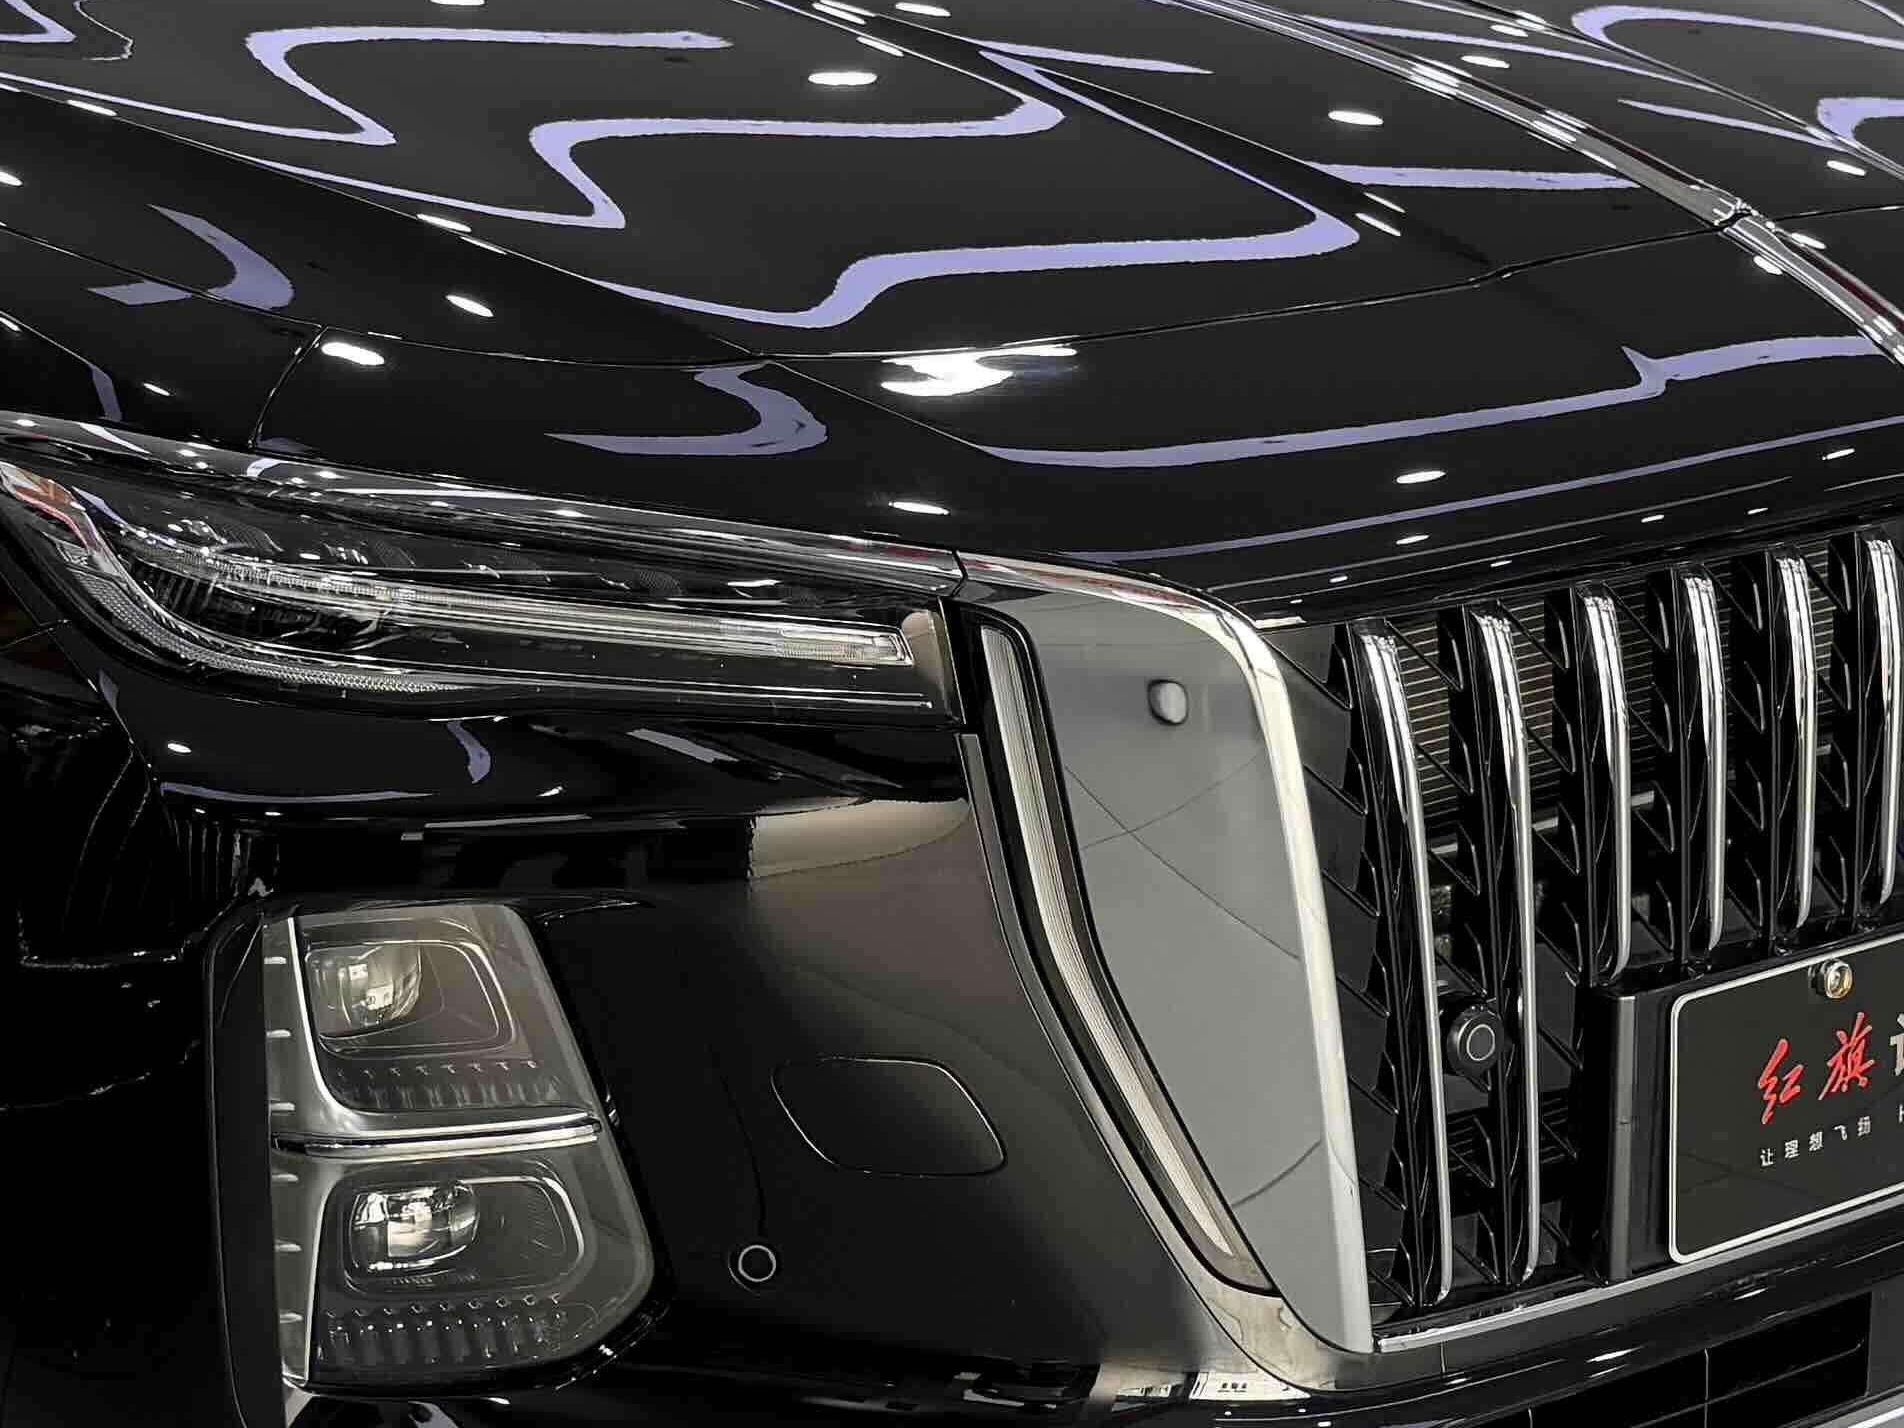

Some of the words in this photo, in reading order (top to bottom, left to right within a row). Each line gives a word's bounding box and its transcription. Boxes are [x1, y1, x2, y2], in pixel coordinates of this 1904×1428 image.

[1758, 1114, 1873, 1168] 让理想飞扬
